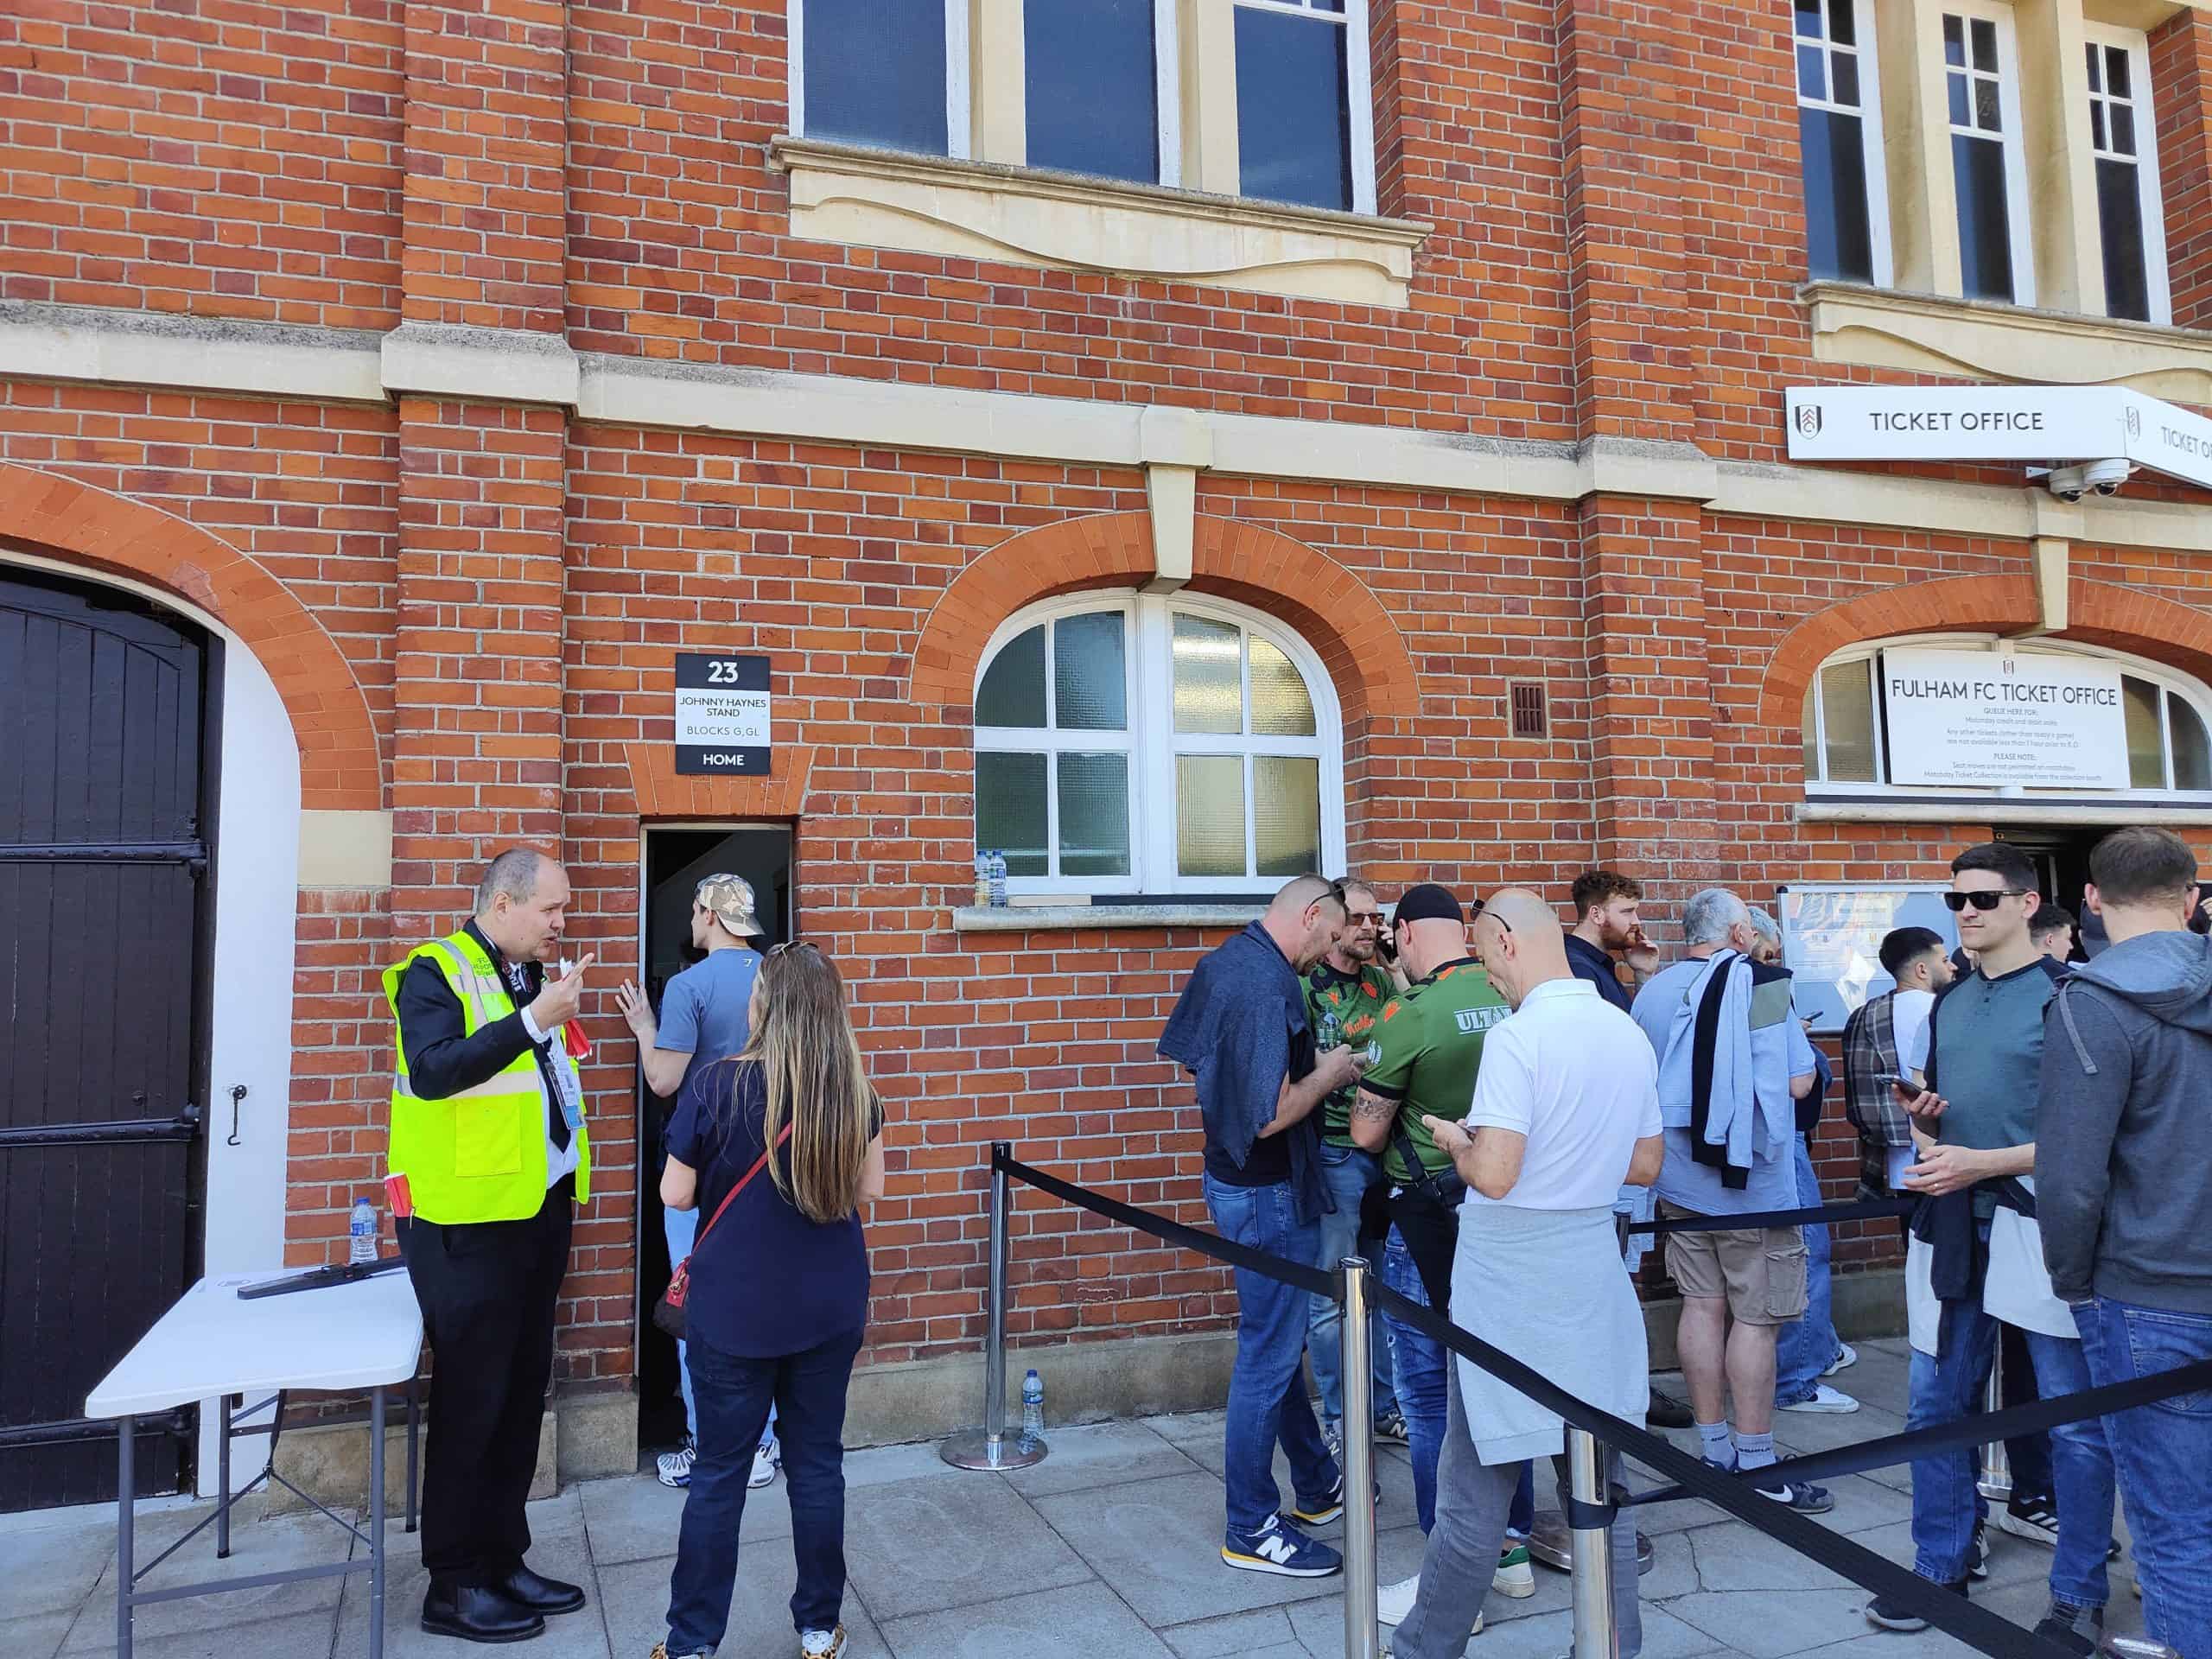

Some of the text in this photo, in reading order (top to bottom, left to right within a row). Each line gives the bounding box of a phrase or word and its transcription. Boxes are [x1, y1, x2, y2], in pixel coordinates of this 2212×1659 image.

[1869, 412, 2044, 430] TICKET OFFICE
[2161, 426, 2212, 460] TICKET O
[708, 661, 739, 683] 23
[1891, 679, 2117, 706] FULHAM FC TICKET OFFICE
[680, 696, 766, 708] JOHNNY HAYNES
[706, 709, 740, 717] STAND
[687, 726, 730, 735] BLOCKS
[702, 754, 745, 766] HOME
